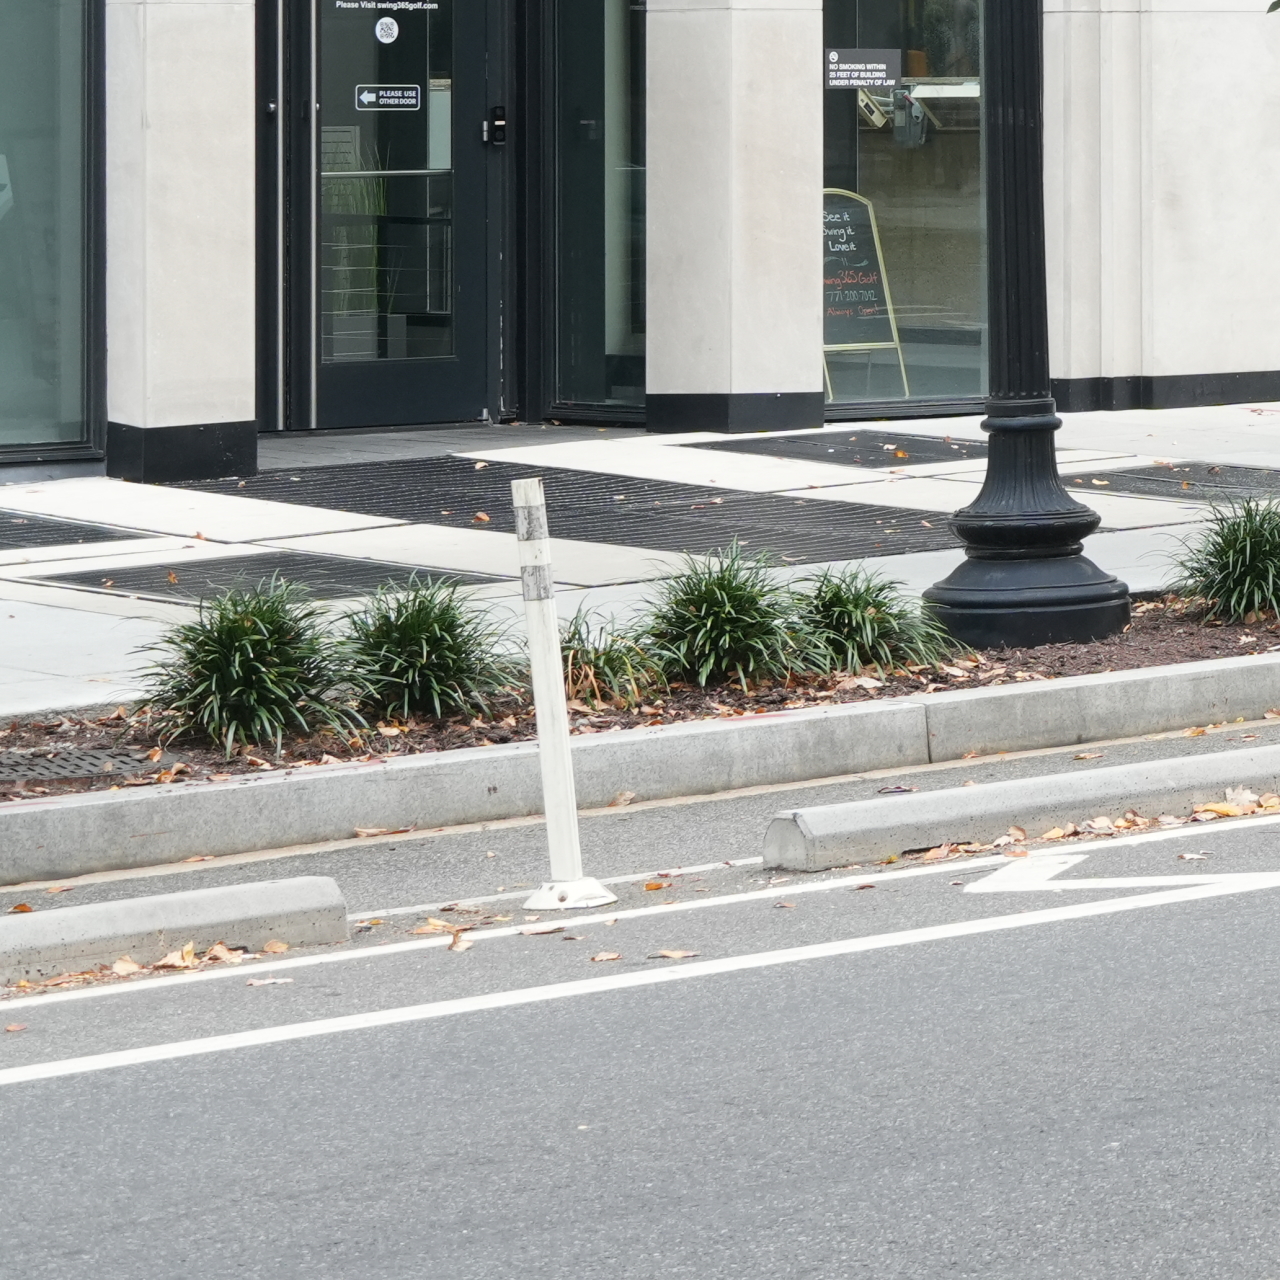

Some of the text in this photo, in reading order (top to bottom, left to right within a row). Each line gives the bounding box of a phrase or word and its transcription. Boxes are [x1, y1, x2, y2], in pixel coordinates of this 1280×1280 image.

[377, 1, 438, 10] swing365golf.com
[843, 211, 850, 221] it
[846, 226, 855, 235] it
